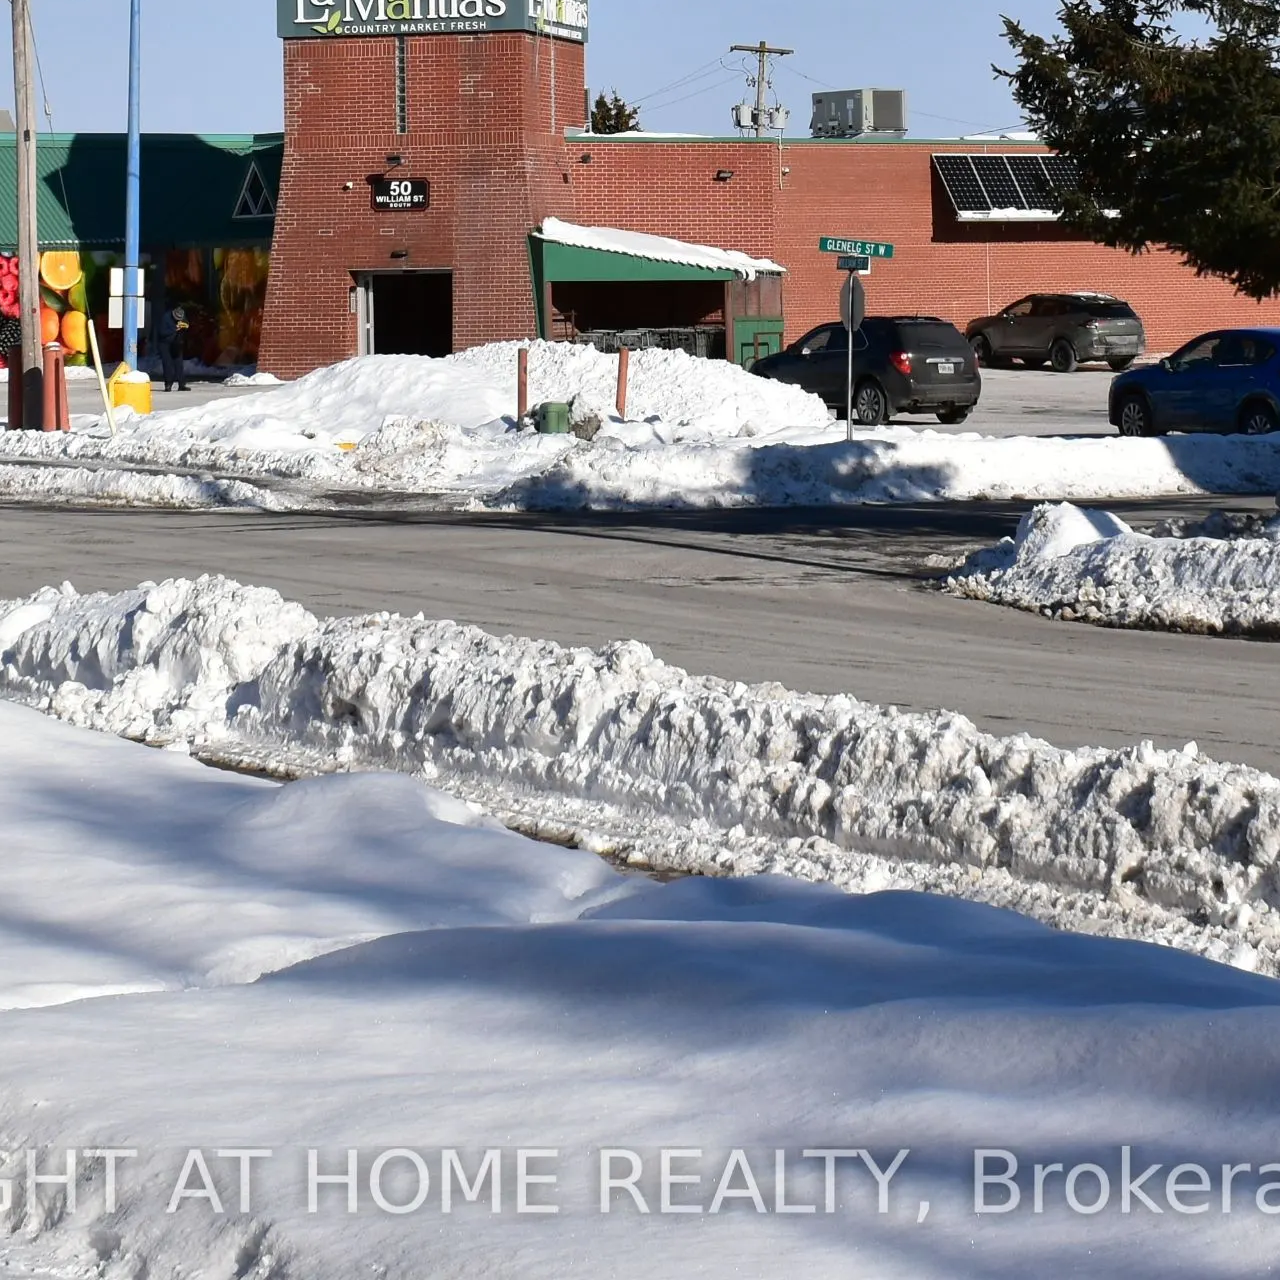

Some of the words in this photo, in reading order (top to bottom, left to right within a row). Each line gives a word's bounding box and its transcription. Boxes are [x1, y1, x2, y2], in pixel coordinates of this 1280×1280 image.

[344, 24, 395, 34] COUNTRY
[401, 22, 446, 32] MARKET
[451, 21, 487, 31] FRESH
[390, 181, 412, 196] 50
[376, 195, 411, 203] WILLIAM
[827, 239, 862, 253] GLENELG
[865, 243, 875, 254] ST
[878, 245, 886, 256] W
